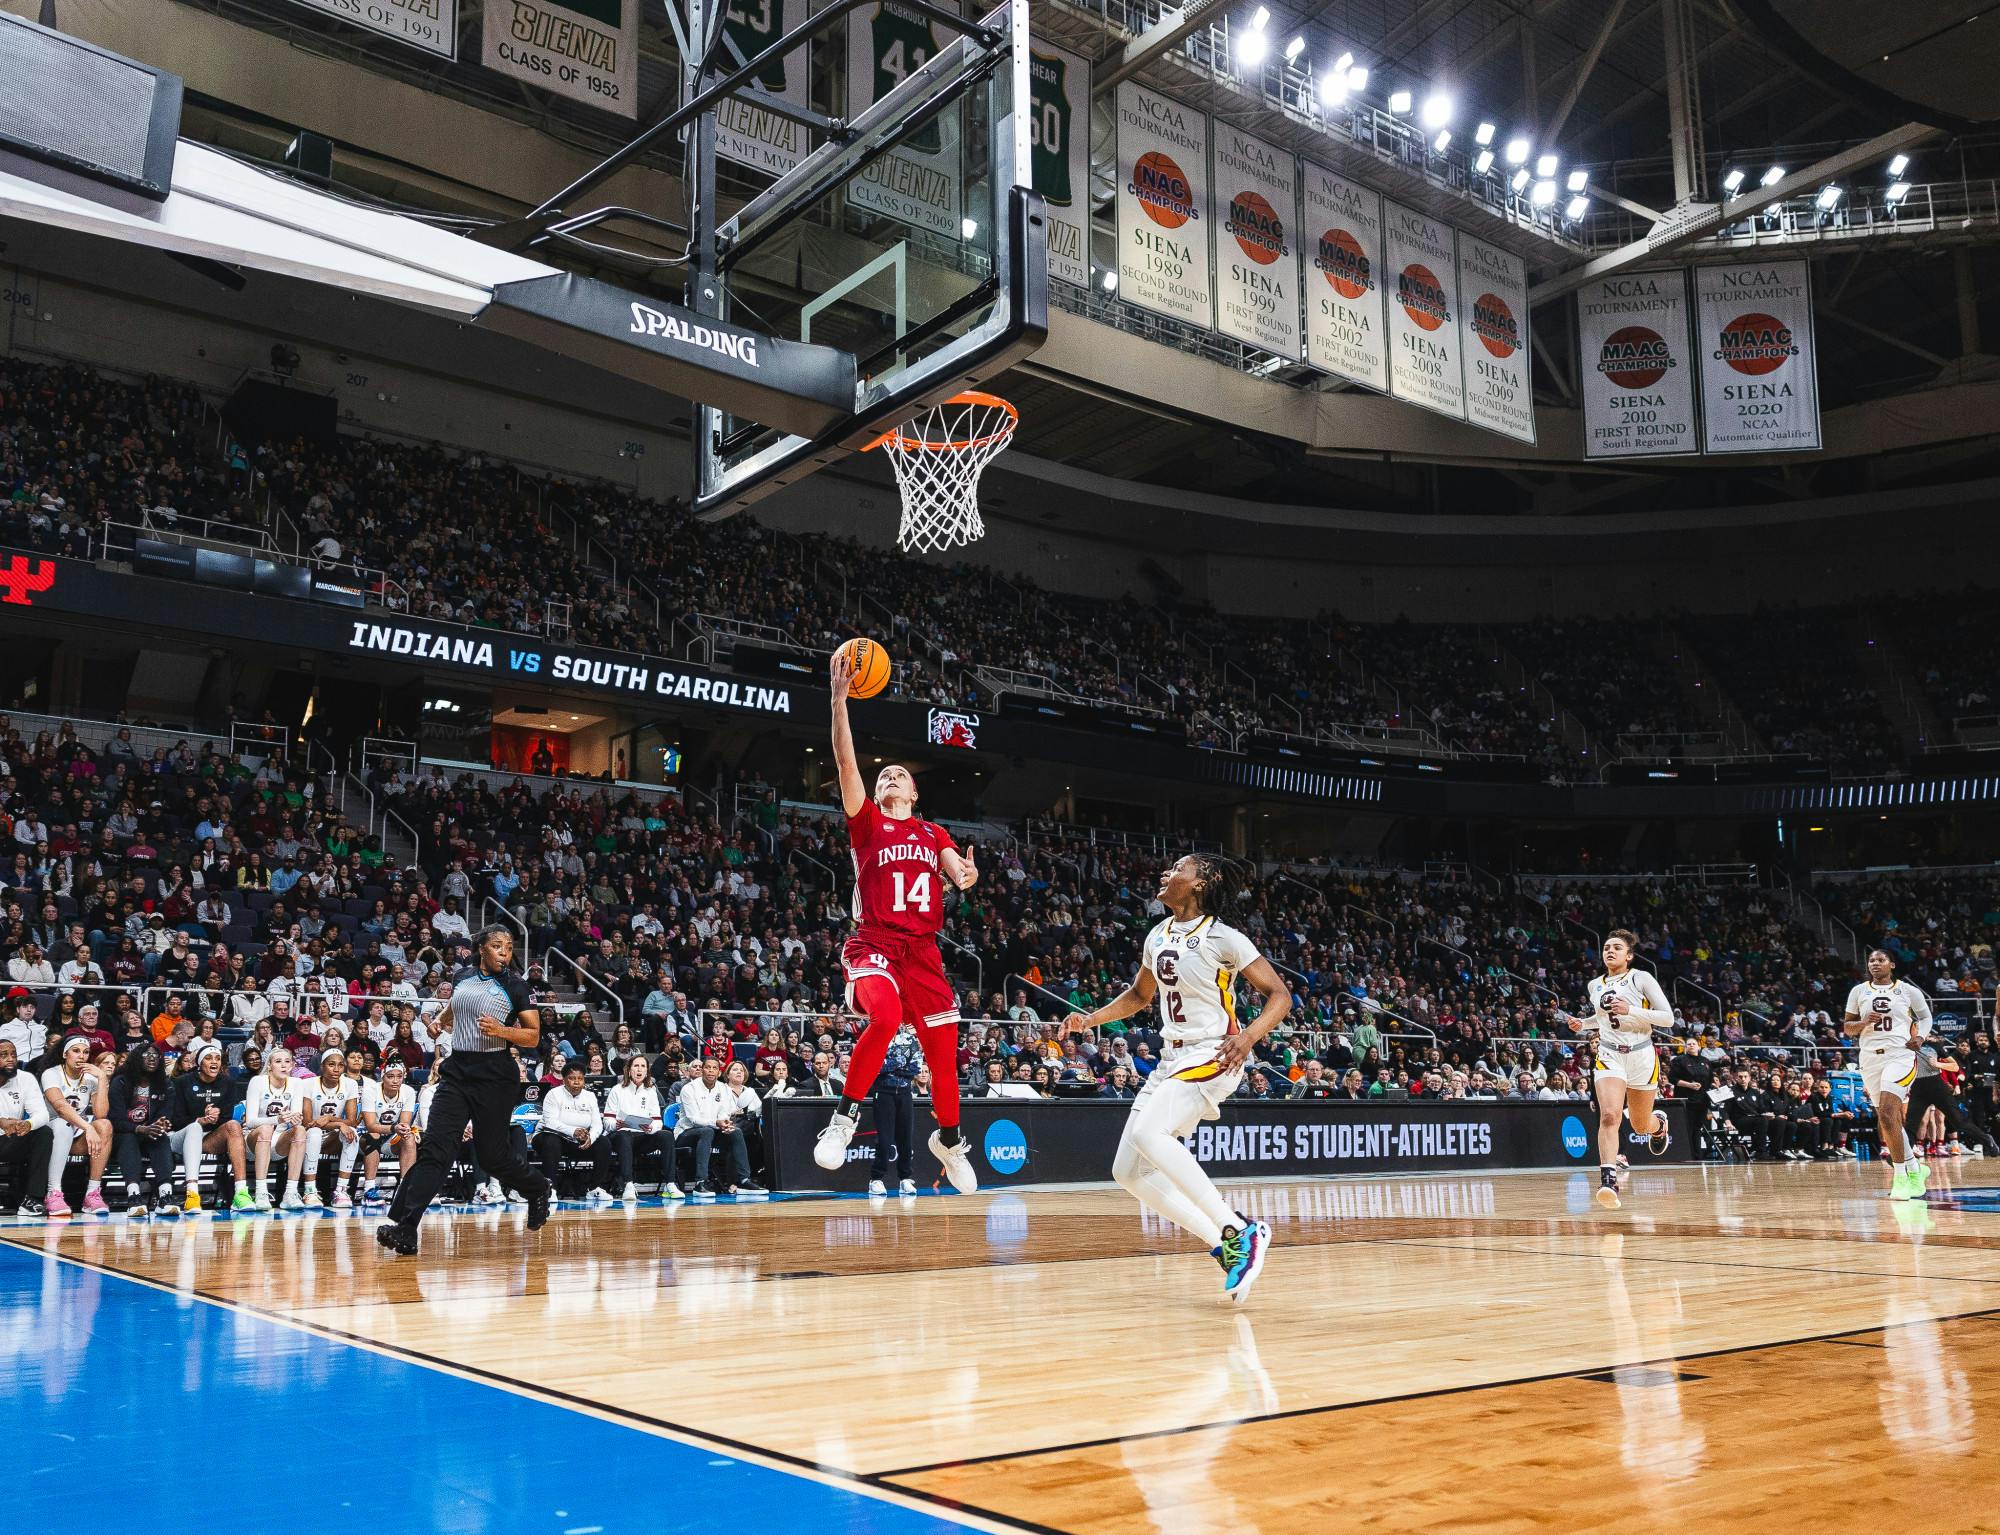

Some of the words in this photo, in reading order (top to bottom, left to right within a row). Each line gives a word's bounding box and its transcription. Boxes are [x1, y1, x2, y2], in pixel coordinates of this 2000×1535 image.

[367, 5, 395, 26] OF
[402, 18, 441, 45] 1991
[511, 0, 617, 74] SIENA
[498, 42, 553, 76] CLASS
[558, 65, 581, 84] OF
[585, 75, 620, 101] 1952
[1028, 60, 1057, 85] HEAR
[716, 97, 797, 153] IENA
[1137, 95, 1186, 131] NCAA
[1121, 108, 1202, 153] TOURNAMENT
[732, 139, 759, 159] NIT
[764, 151, 797, 171] MVP
[1233, 136, 1276, 171] NCAA
[1141, 164, 1185, 199] NAC
[1218, 151, 1291, 193] TOURNAMENT
[1127, 182, 1200, 221] CHAMPIONS
[1321, 176, 1363, 209] NCAA
[855, 185, 899, 212] CLASS
[902, 203, 922, 219] OF
[925, 211, 954, 231] 2009
[1229, 200, 1284, 239] MAAC
[1307, 189, 1377, 231] TOURNAMENT
[1224, 220, 1290, 257] CHAMPIONS
[1401, 214, 1439, 244] NCAA
[1135, 228, 1193, 265] SIENA
[1318, 237, 1371, 275] MAAC
[1388, 229, 1451, 263] TOURNAMENT
[1474, 244, 1510, 274] NCAA
[1060, 262, 1084, 281] 1973
[1145, 253, 1184, 280] 1989
[1232, 264, 1285, 299] SIENA
[1314, 256, 1376, 292] CHAMPIONS
[1463, 258, 1523, 292] TOURNAMENT
[1722, 270, 1781, 288] NCAA
[2, 288, 31, 306] 206
[1121, 264, 1166, 291] SECOND
[1169, 282, 1209, 305] ROUND
[1137, 284, 1155, 299] East
[1157, 290, 1194, 313] Regional
[1399, 272, 1447, 307] MAAC
[1602, 279, 1661, 298] NCAA
[1702, 286, 1802, 303] TOURNAMENT
[1242, 288, 1276, 314] 1999
[1321, 298, 1371, 332] SIENA
[1395, 292, 1453, 323] CHAMPIONS
[1585, 298, 1679, 316] TOURNAMENT
[1226, 301, 1254, 321] FIRST
[1256, 313, 1292, 335] ROUND
[1473, 299, 1518, 334] MAAC
[630, 302, 760, 368] SPALDING
[1233, 318, 1252, 333] West
[1255, 327, 1286, 346] Regional
[1330, 321, 1364, 348] 2002
[1402, 332, 1450, 362] SIENA
[1470, 321, 1523, 351] CHAMPIONS
[1719, 328, 1793, 348] MAAC
[1315, 334, 1342, 355] FIRST
[1343, 342, 1379, 367] ROUND
[1323, 350, 1341, 365] East
[1340, 355, 1372, 378] Regional
[1602, 340, 1669, 360] MAAC
[1713, 345, 1800, 361] CHAMPIONS
[346, 373, 369, 387] 207
[1411, 354, 1443, 378] 2008
[1476, 359, 1520, 389] SIENA
[1596, 358, 1677, 373] CHAMPIONS
[1394, 364, 1428, 387] SECOND
[1429, 376, 1462, 398] ROUND
[1400, 379, 1426, 399] Midwest
[1426, 387, 1458, 408] Regional
[1485, 380, 1515, 402] 2009
[1723, 382, 1794, 401] SIENA
[1468, 390, 1502, 413] SECOND
[1502, 404, 1532, 422] ROUND
[1609, 395, 1666, 409] SIENA
[1621, 410, 1657, 424] 2010
[1737, 402, 1783, 416] 2020
[1473, 406, 1501, 424] Midwest
[1501, 414, 1528, 432] Regional
[1595, 426, 1632, 439] FIRST
[1637, 423, 1687, 436] ROUND
[1743, 419, 1779, 430] NCAA
[1602, 438, 1632, 450] South
[1634, 436, 1679, 450] Regional
[1712, 431, 1764, 443] Automatic
[1766, 429, 1814, 442] Qualifier
[349, 622, 494, 668] INDIANA
[509, 649, 542, 673] VS
[552, 654, 649, 692] SOUTH
[656, 672, 791, 714] CAROLINA
[878, 844, 938, 873] INDIANA
[892, 871, 931, 913] 14
[1166, 990, 1187, 1023] 12
[1608, 1012, 1621, 1030] 5
[1873, 1016, 1893, 1032] 20
[989, 1145, 1028, 1160] NCAA
[1294, 1123, 1492, 1159] STUDENT-ATHLETES
[1565, 1136, 1588, 1148] NCAA
